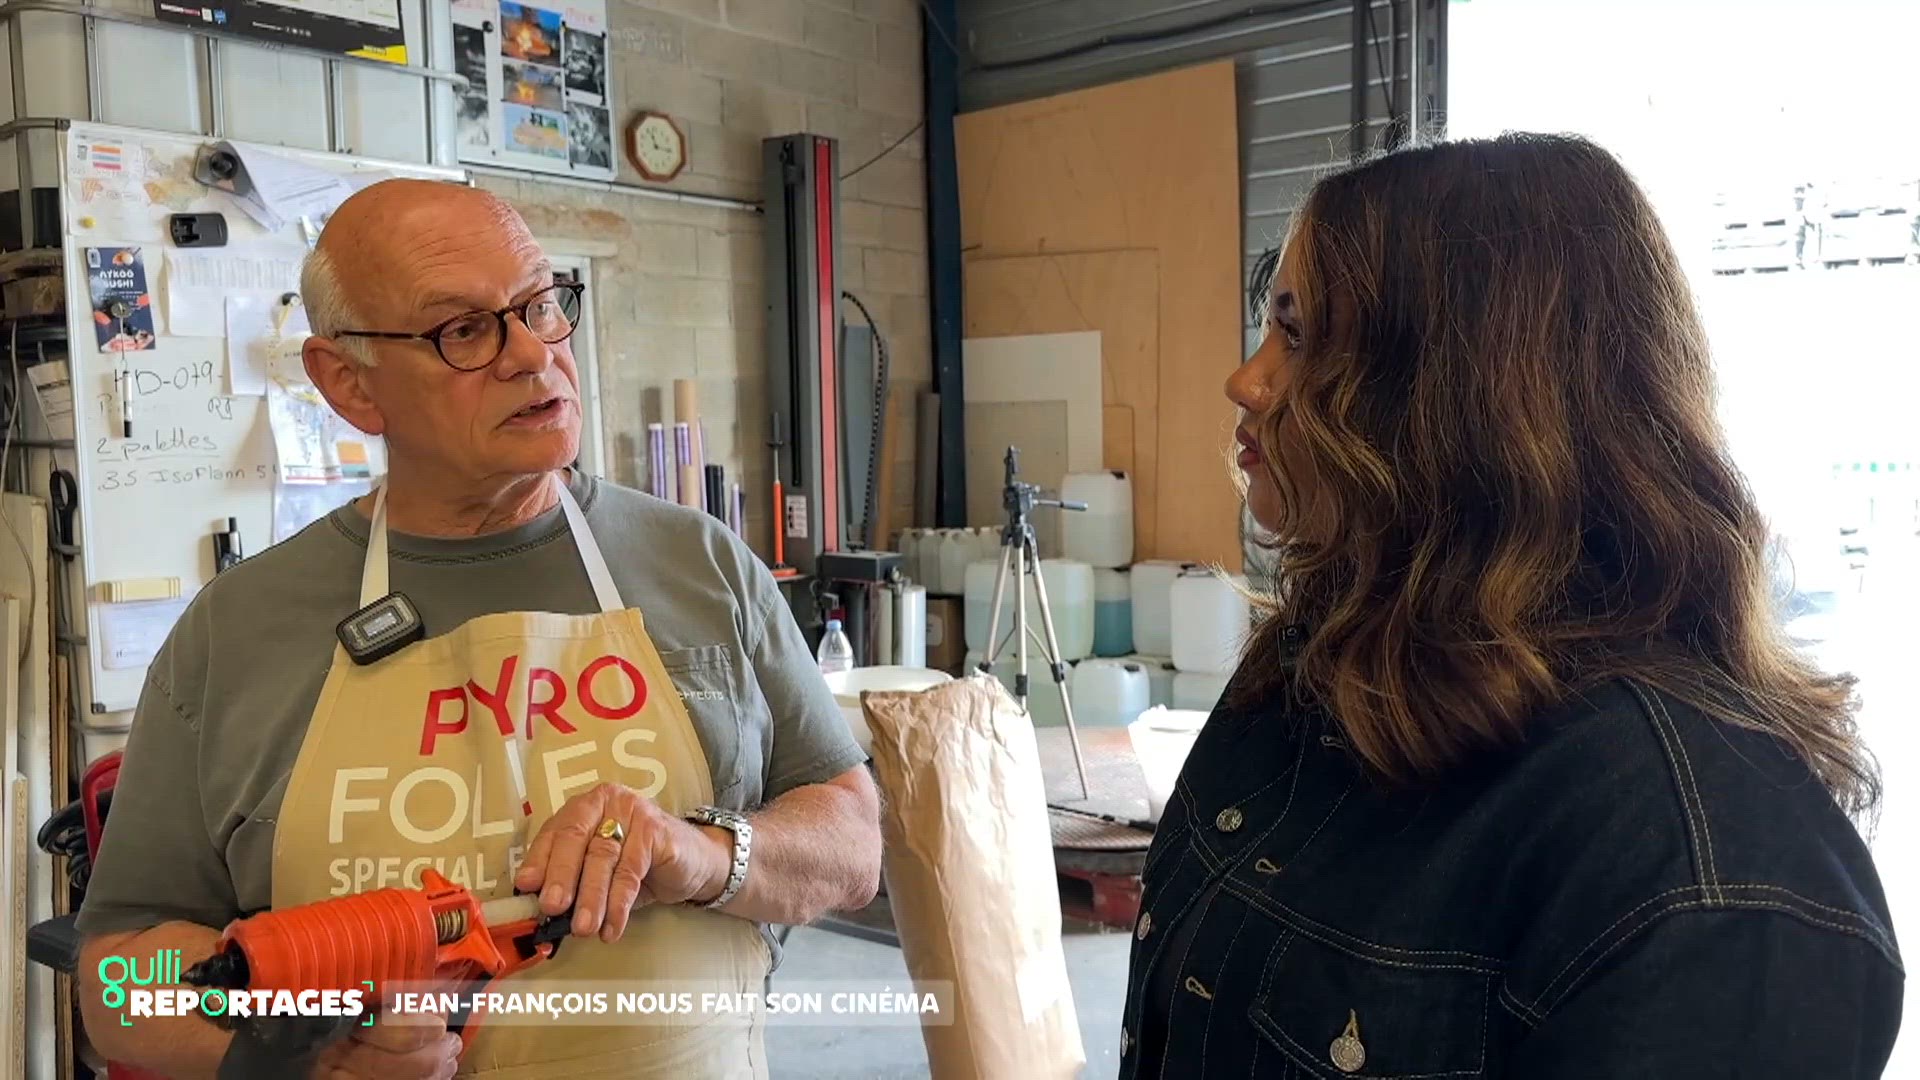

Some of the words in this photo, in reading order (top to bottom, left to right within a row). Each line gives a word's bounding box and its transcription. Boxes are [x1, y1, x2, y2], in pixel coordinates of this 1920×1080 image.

[96, 437, 112, 454] 2
[121, 427, 218, 460] palettes
[419, 654, 648, 756] PYRO
[328, 853, 497, 896] SPECIAL
